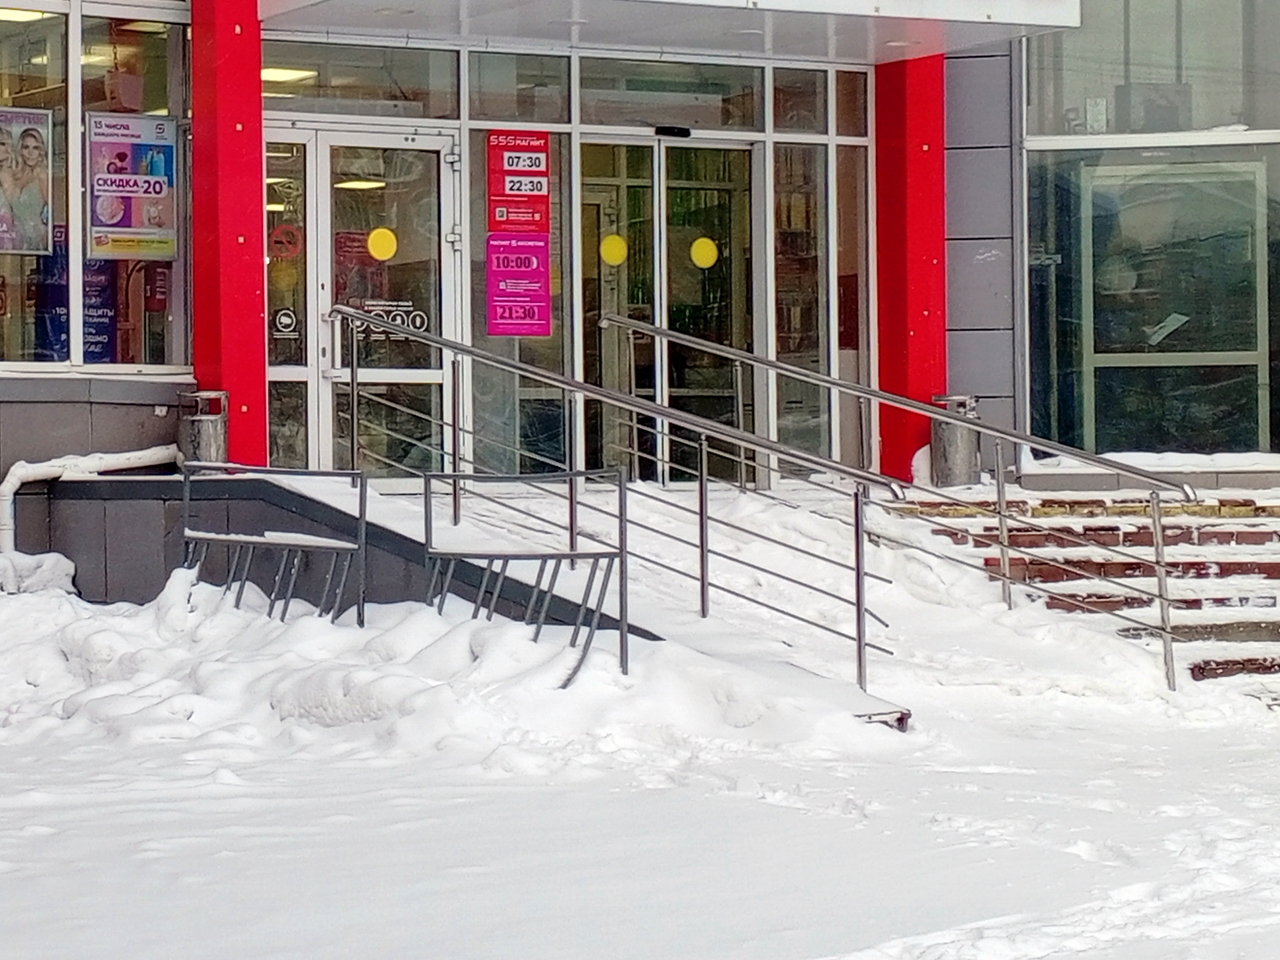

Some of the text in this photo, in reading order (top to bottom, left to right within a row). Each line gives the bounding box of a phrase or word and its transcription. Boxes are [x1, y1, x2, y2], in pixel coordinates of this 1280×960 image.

[507, 156, 542, 168] 07:30
[96, 177, 140, 189] СКИДКА
[508, 180, 543, 192] 22:30
[495, 256, 531, 269] 10:00
[498, 307, 536, 320] 21:30
